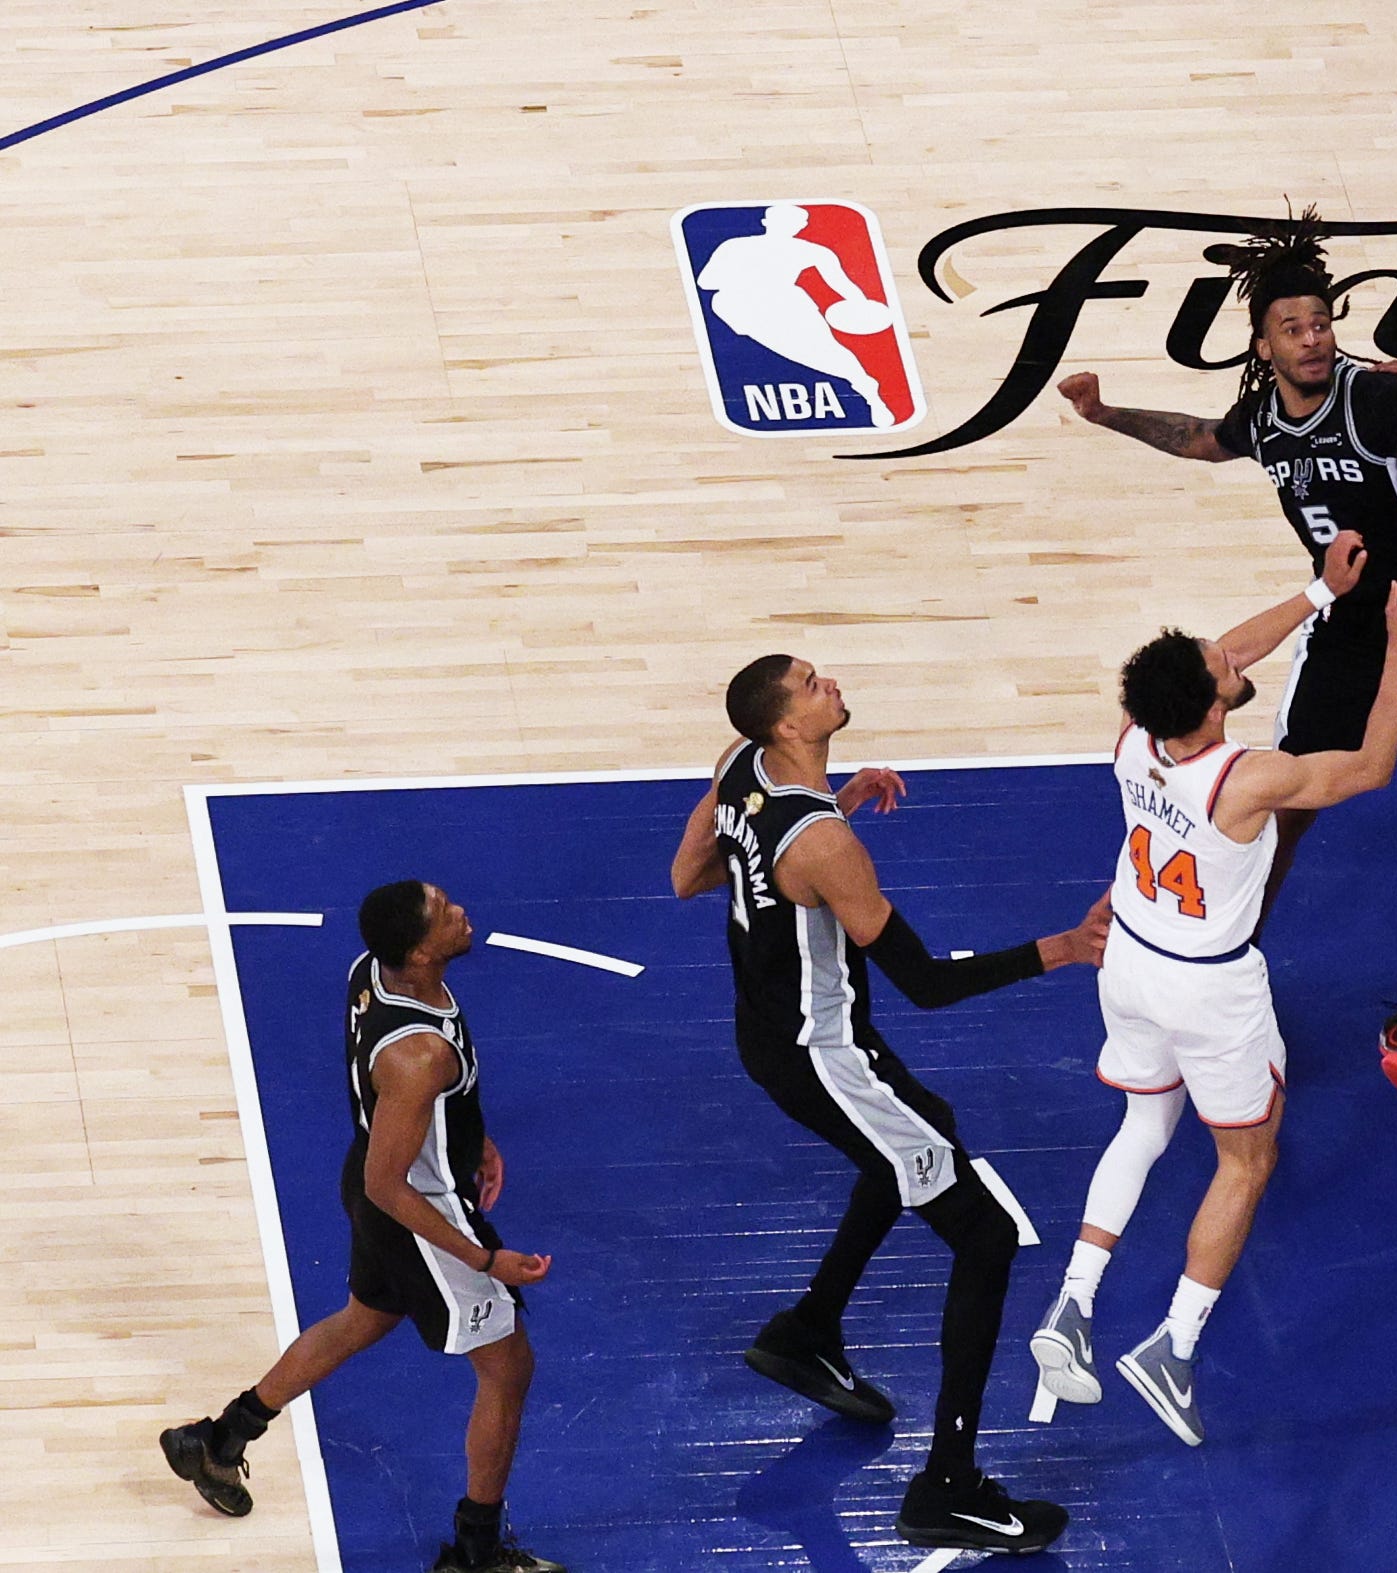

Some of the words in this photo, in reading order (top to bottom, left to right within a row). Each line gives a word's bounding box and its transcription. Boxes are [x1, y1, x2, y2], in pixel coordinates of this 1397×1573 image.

[744, 382, 845, 422] NBA
[1301, 505, 1339, 544] 5
[1126, 779, 1196, 839] SHAMET
[1129, 824, 1206, 920] 44
